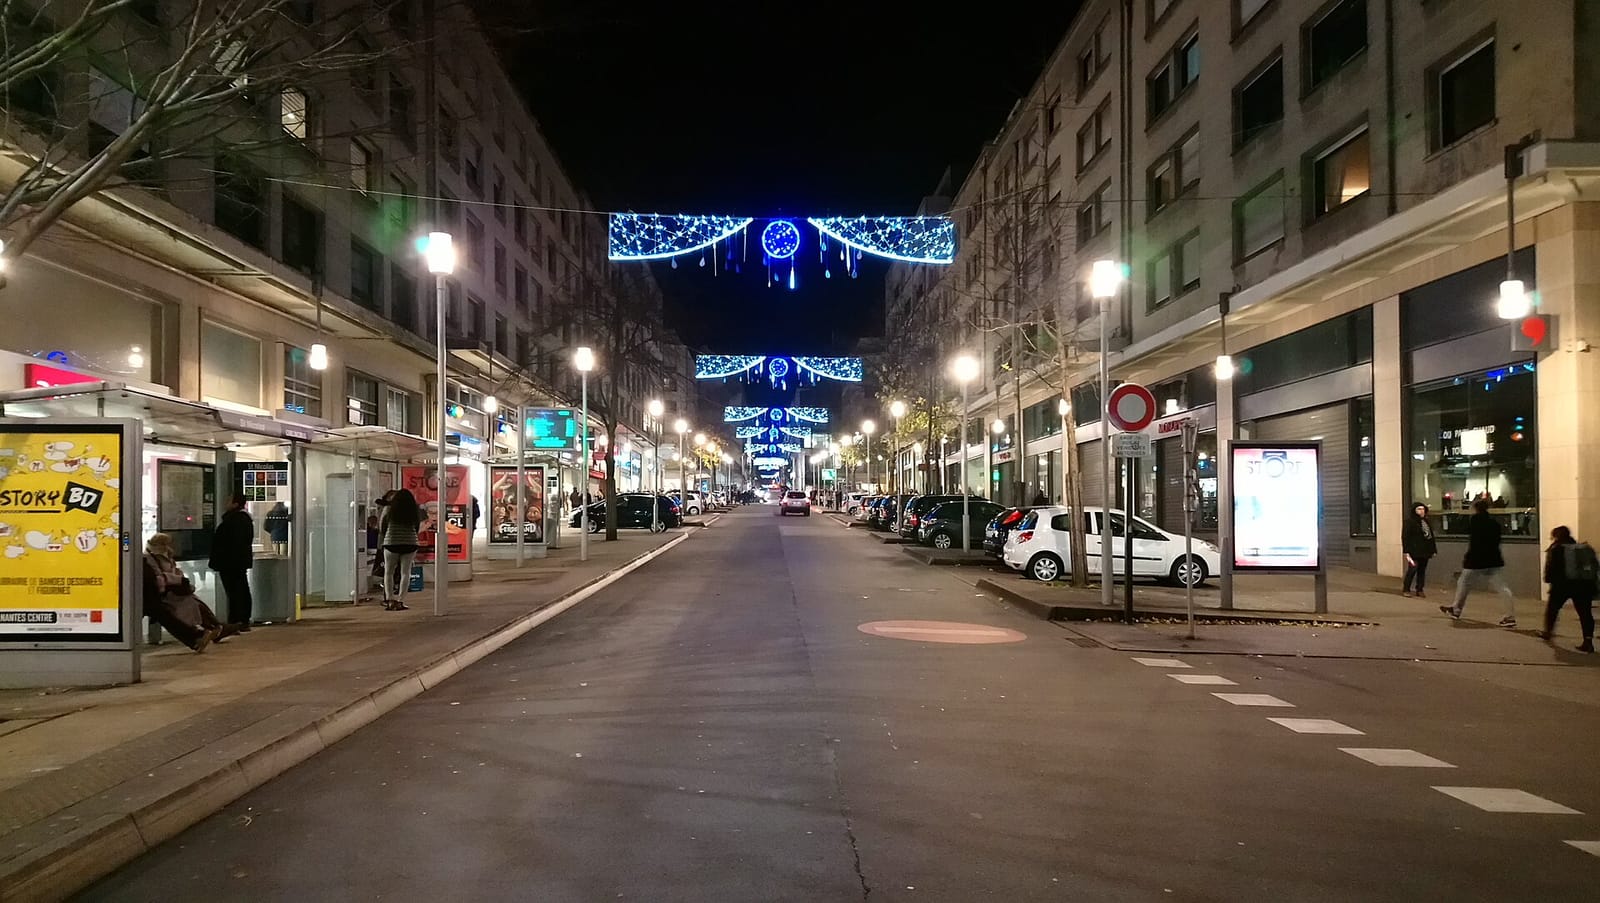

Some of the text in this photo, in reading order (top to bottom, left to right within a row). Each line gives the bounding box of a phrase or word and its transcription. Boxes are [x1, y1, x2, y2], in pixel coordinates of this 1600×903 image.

[0, 487, 97, 507] STORY BD
[0, 613, 26, 622] NANTES
[28, 613, 53, 622] CENTRE
